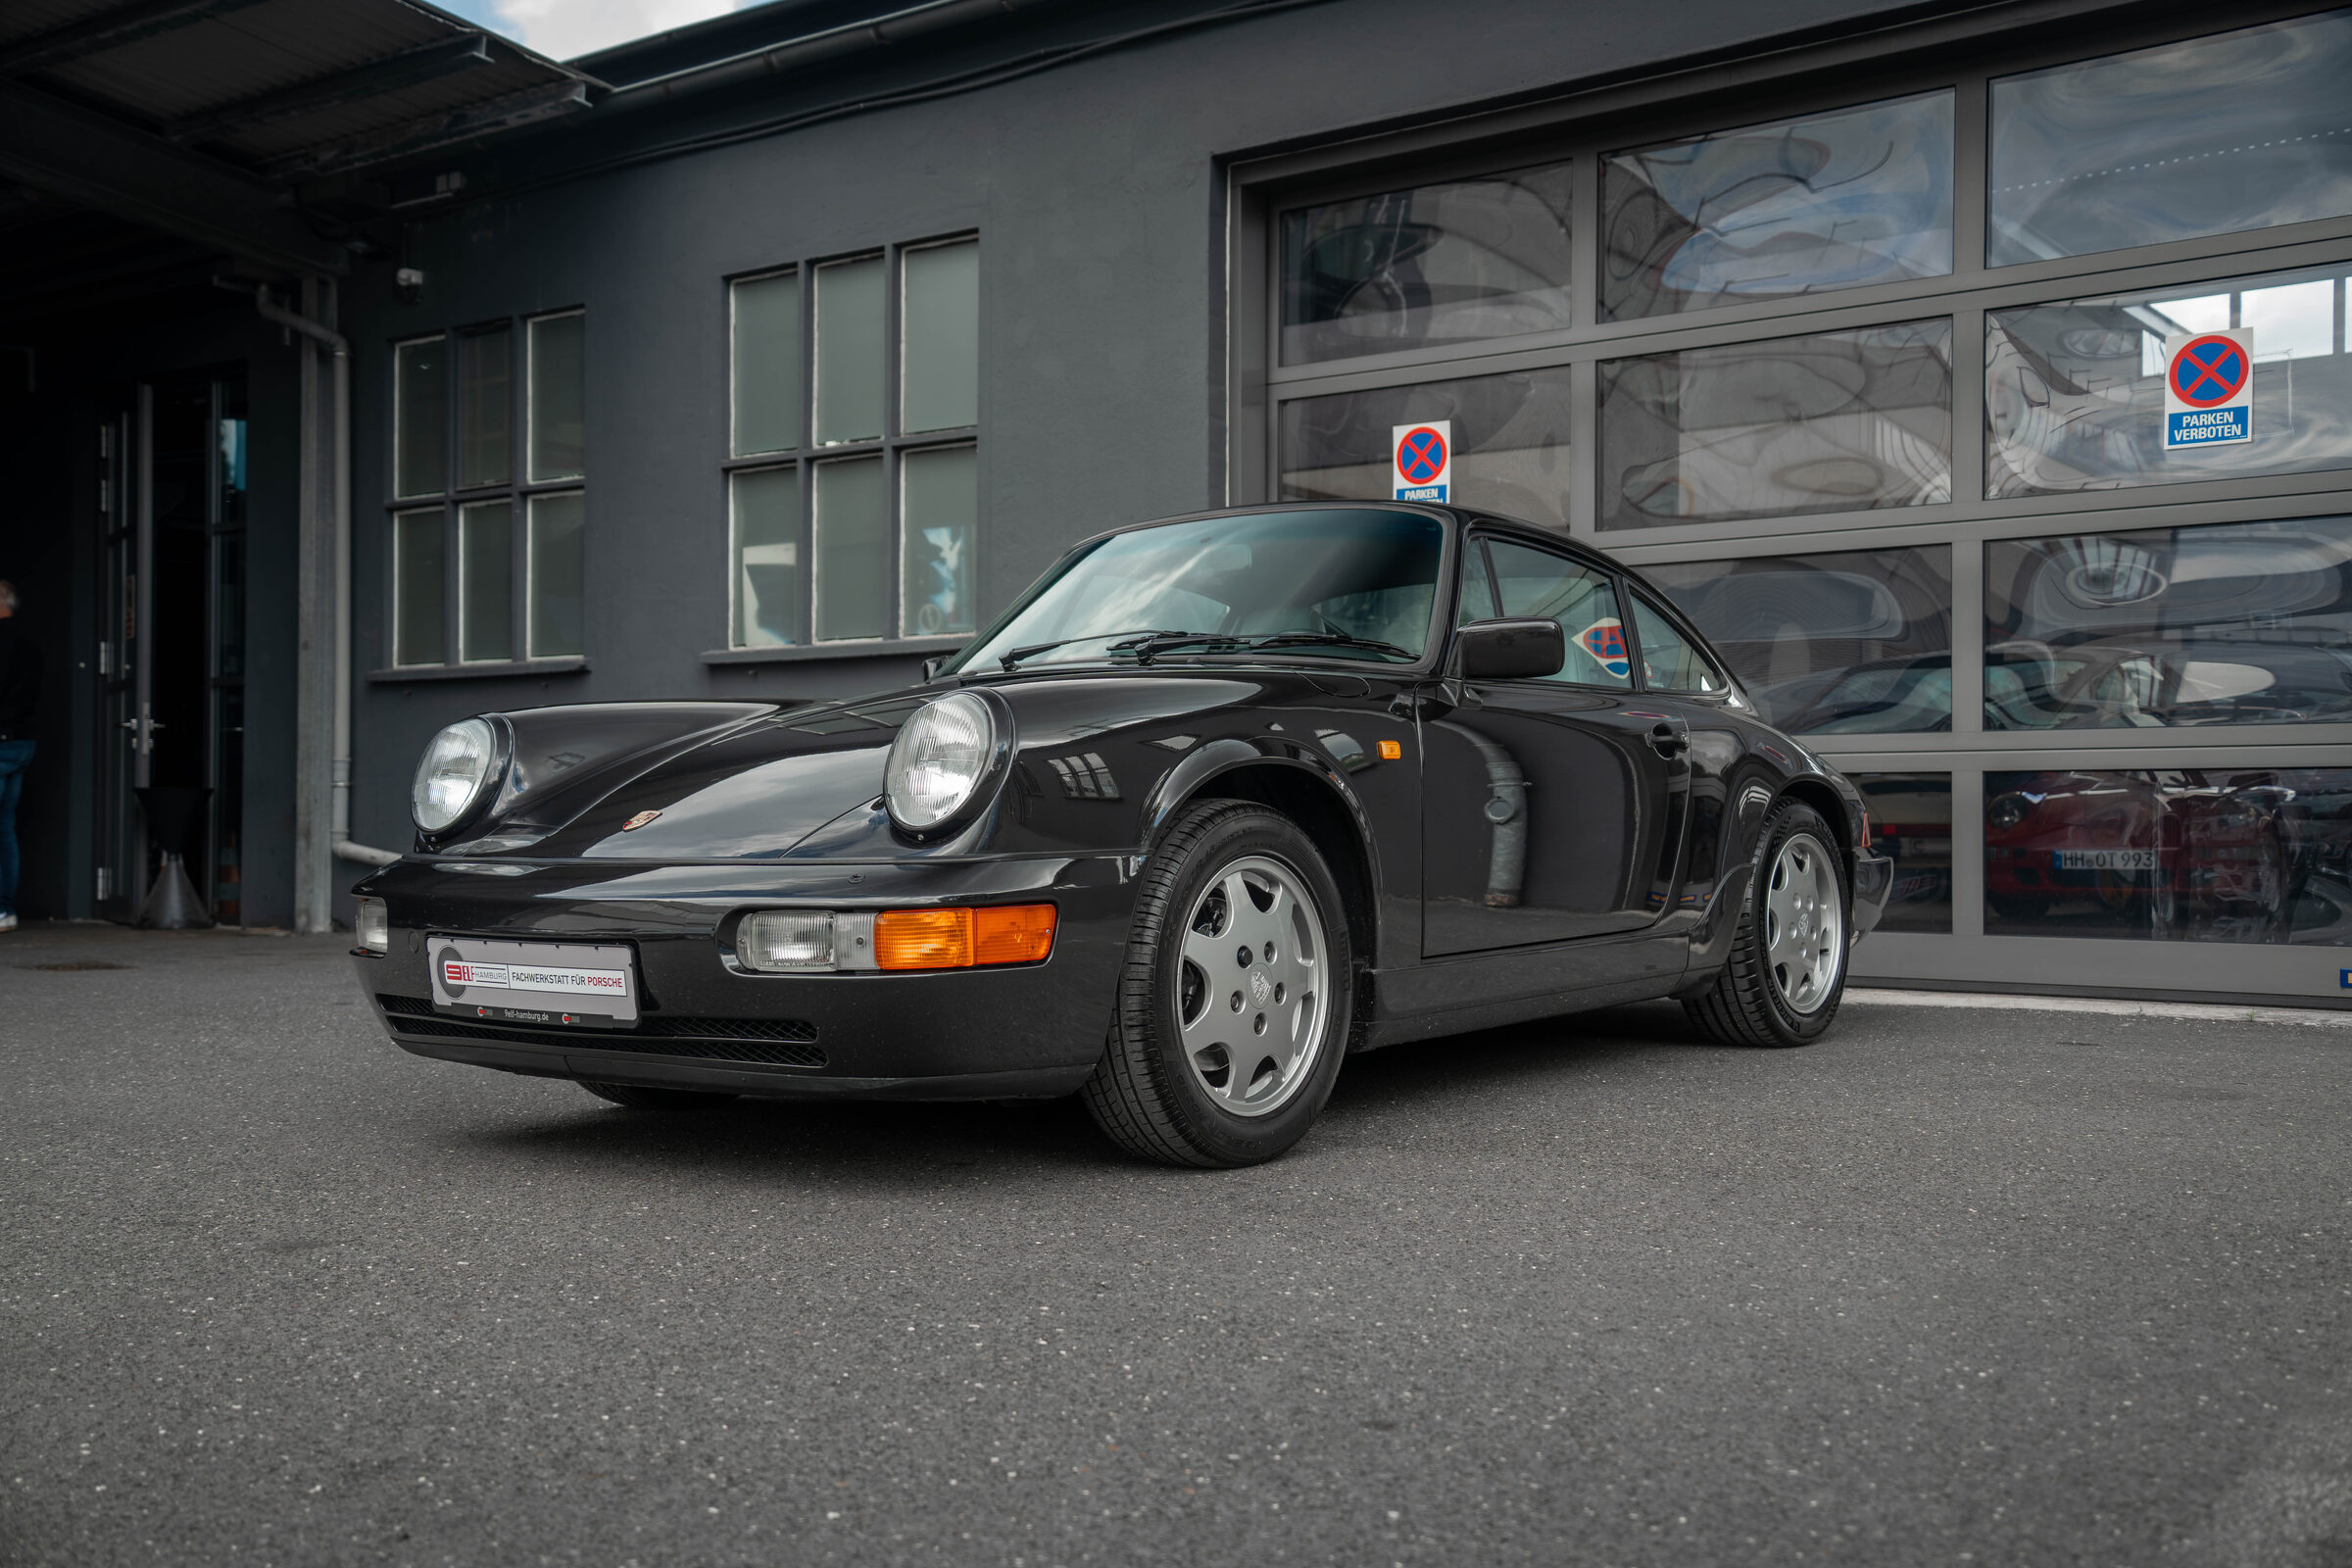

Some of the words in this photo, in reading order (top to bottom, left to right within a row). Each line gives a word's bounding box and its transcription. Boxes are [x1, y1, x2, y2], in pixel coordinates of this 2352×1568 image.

[2182, 412, 2233, 427] PARKEN
[2174, 423, 2241, 441] VERBOTEN
[1405, 488, 1438, 501] PARKEN
[2064, 852, 2084, 867] HH
[2095, 852, 2117, 867] OT
[2121, 851, 2153, 867] 993
[475, 971, 507, 980] HAMBURG
[512, 971, 569, 985] FACHWERKSTATT
[570, 974, 586, 986] FÜR
[587, 976, 623, 988] PORSCHE
[504, 1008, 549, 1022] 9elf-hamburg.de
